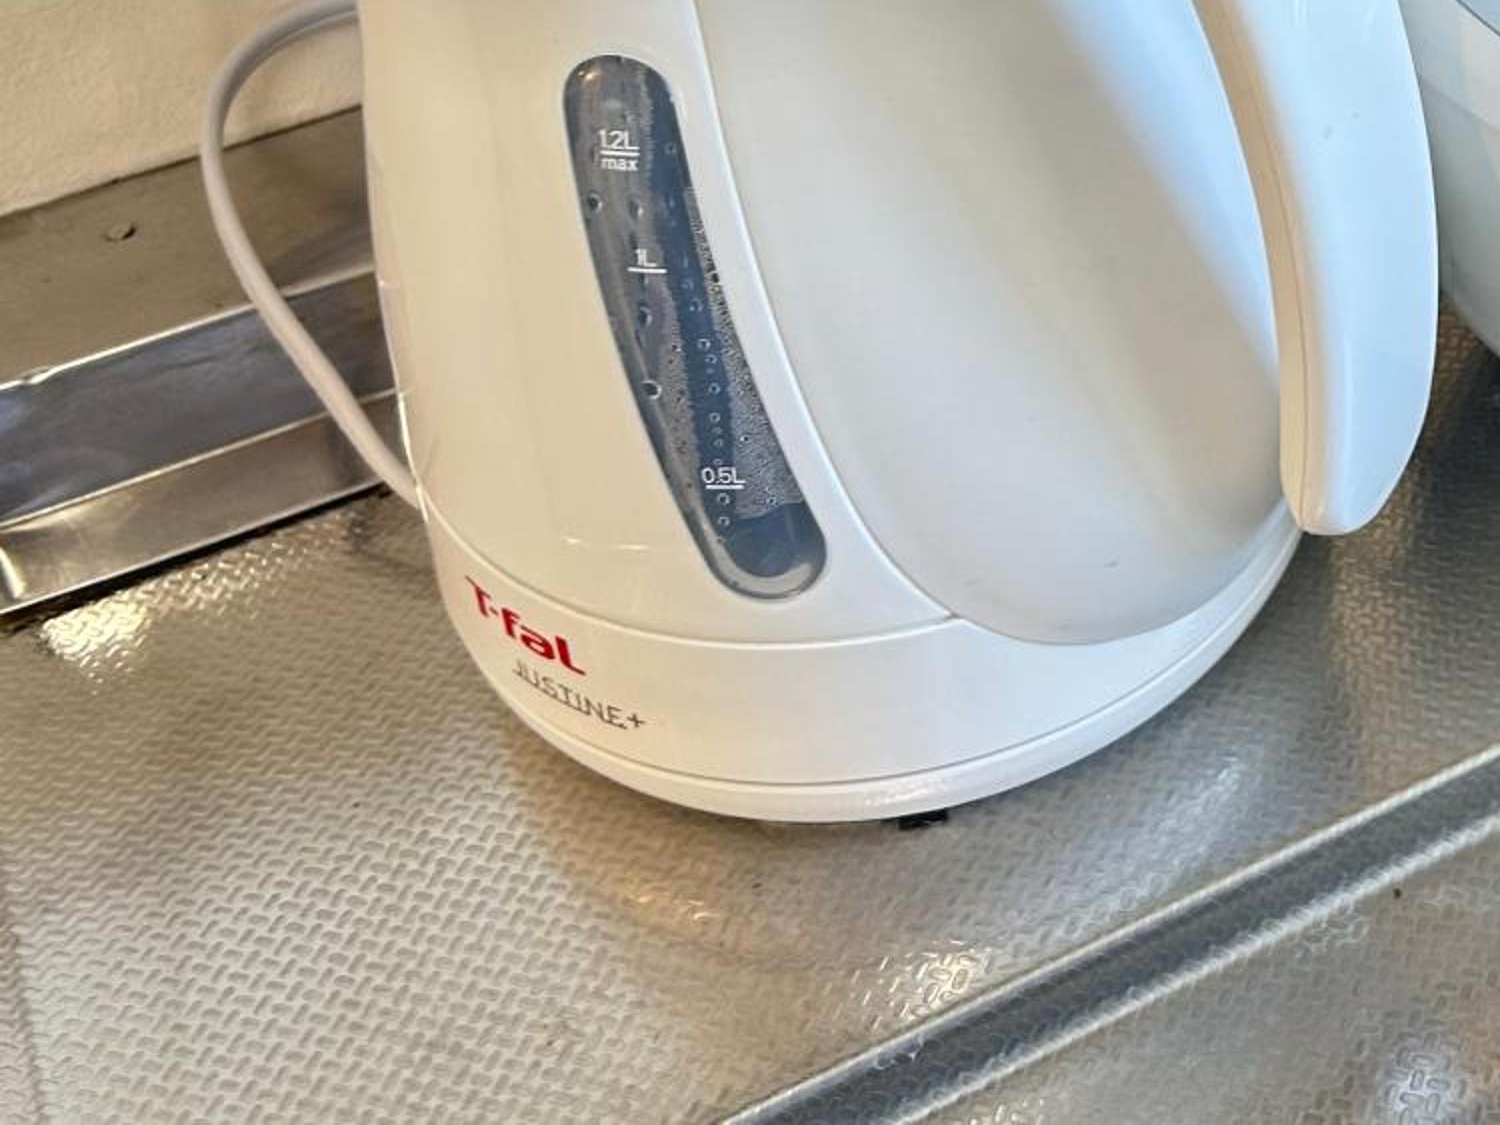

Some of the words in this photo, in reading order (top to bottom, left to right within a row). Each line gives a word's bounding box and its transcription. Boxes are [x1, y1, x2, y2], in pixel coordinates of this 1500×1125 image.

[601, 158, 639, 171] max
[634, 248, 657, 268] 1L
[701, 466, 746, 484] 0.5L
[465, 575, 587, 676] T-fal
